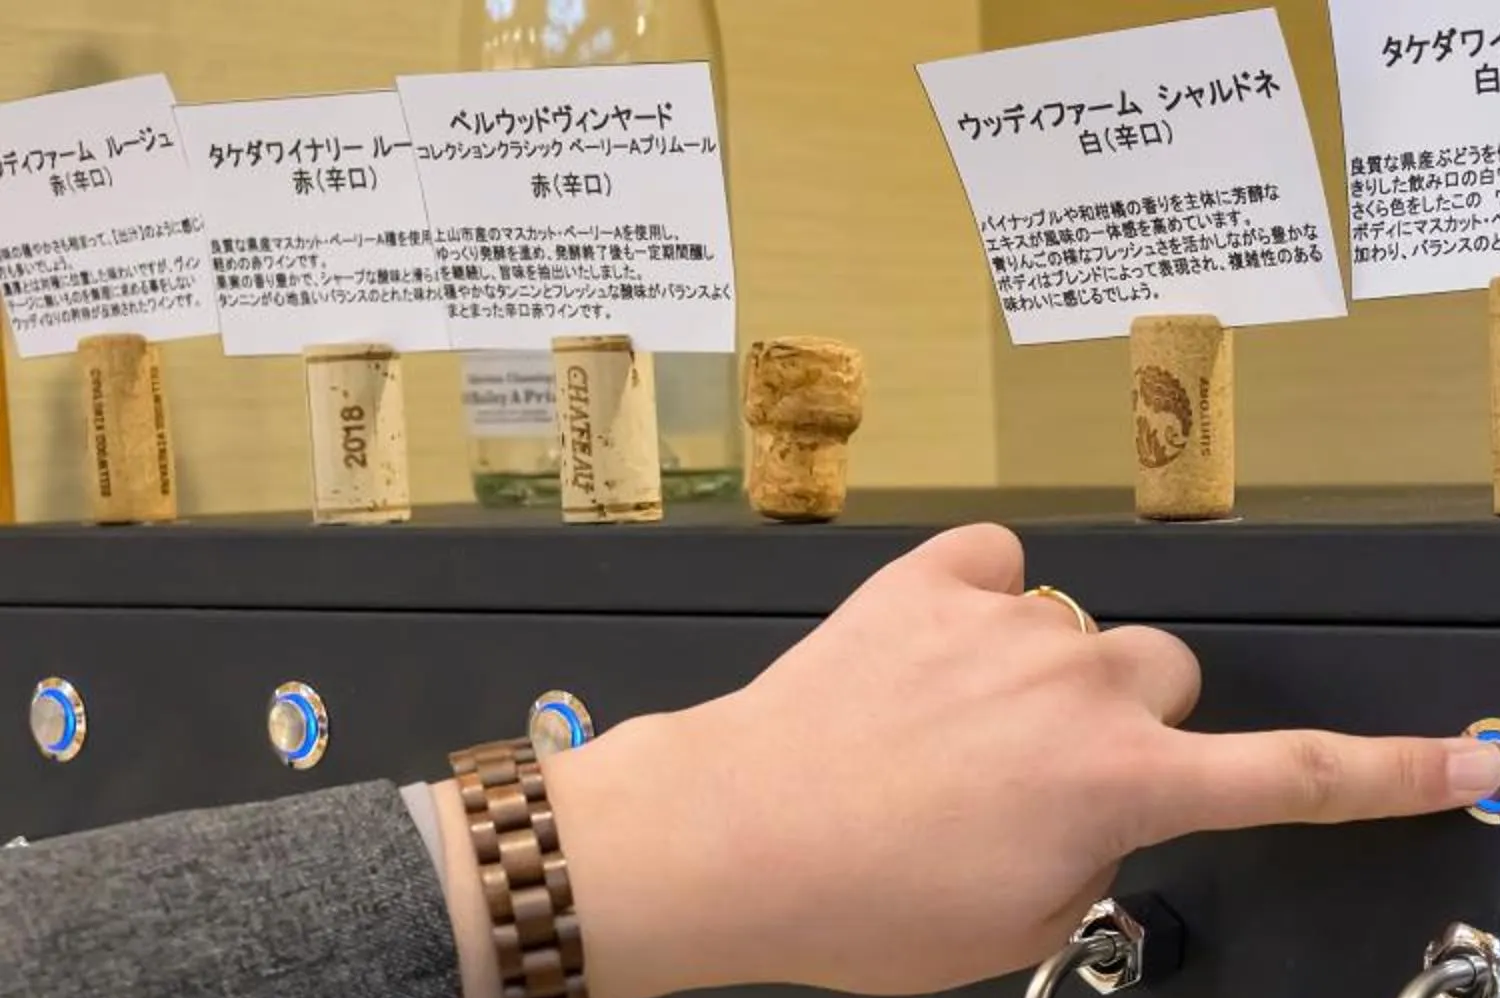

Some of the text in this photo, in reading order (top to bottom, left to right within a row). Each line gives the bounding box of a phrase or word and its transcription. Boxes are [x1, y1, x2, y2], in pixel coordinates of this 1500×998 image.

[450, 103, 673, 135] ベルウッドヴィンヤード
[957, 69, 1280, 141] ウッディファーム シャルドネ
[208, 136, 412, 169] タケダワイナリー ルー
[1078, 119, 1174, 155] 白(辛口)
[0, 139, 96, 177] ディファーム
[339, 404, 368, 469] 2018
